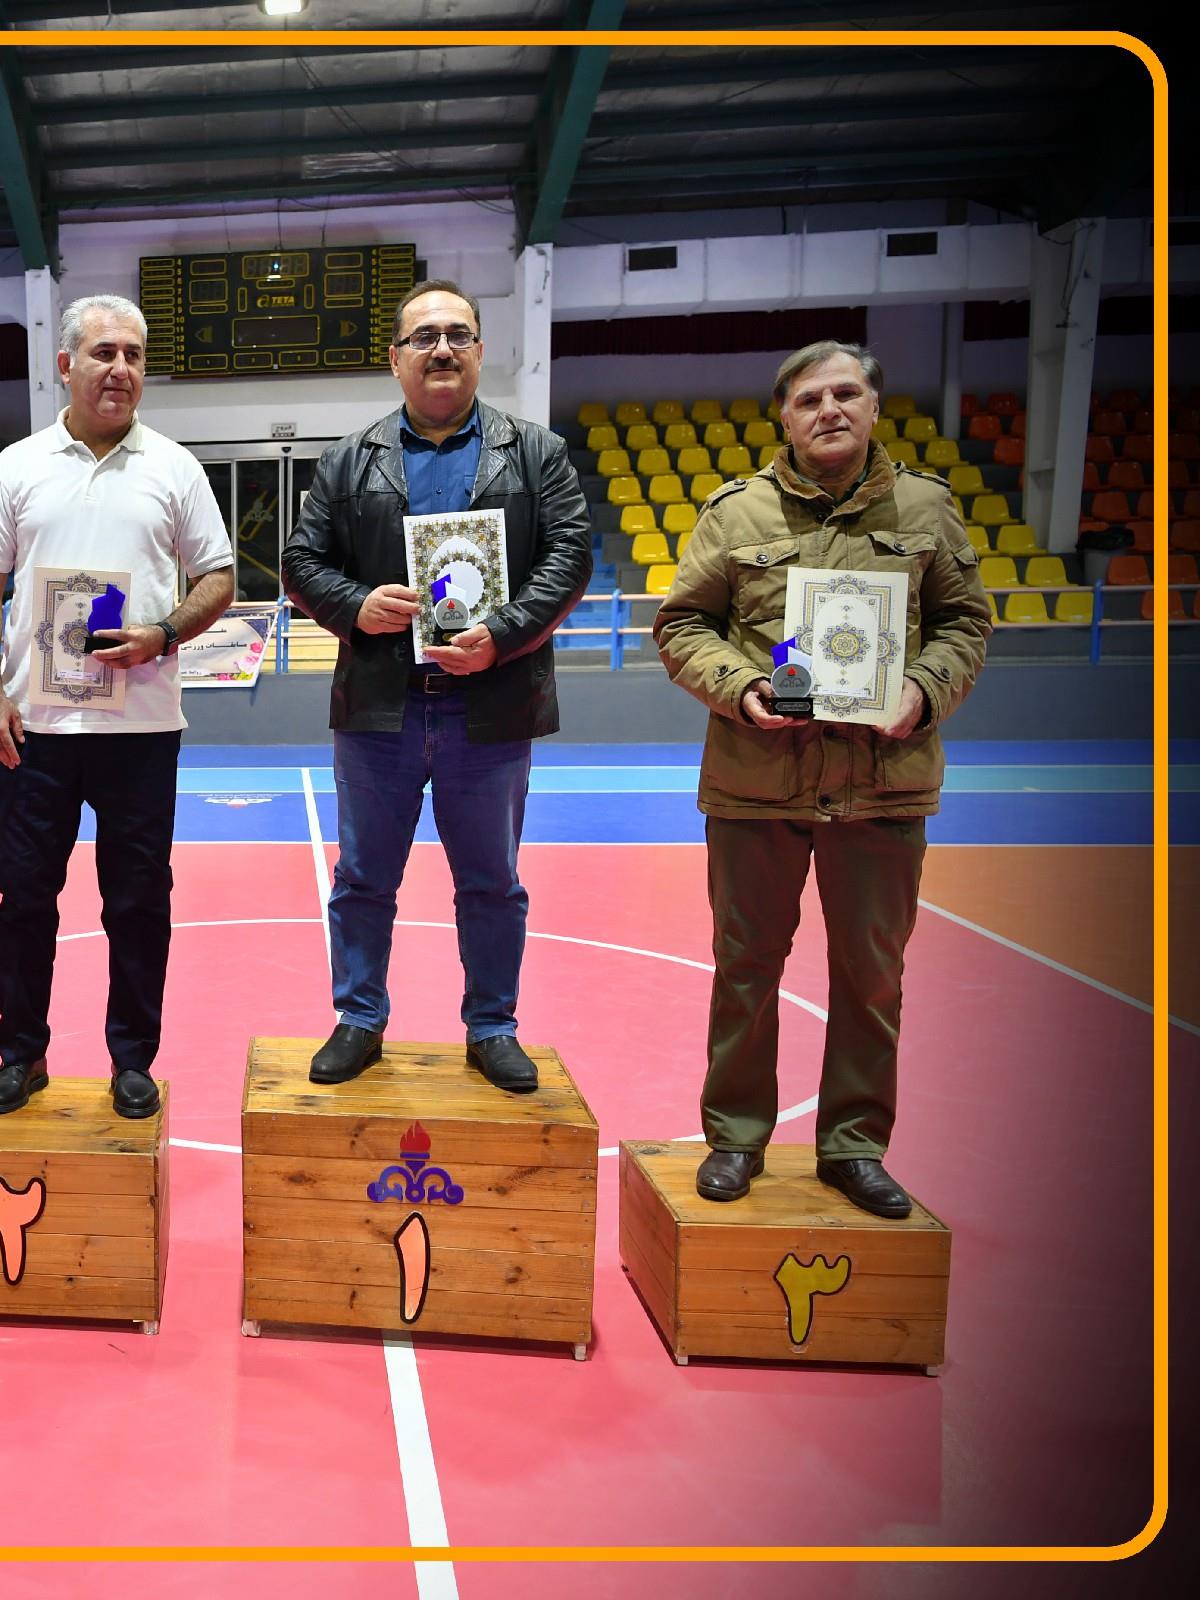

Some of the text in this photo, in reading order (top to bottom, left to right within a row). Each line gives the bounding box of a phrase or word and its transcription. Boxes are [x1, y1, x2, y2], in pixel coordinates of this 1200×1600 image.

[272, 296, 295, 304] TETA
[394, 1211, 431, 1324] ۱
[773, 1253, 851, 1345] ۳
